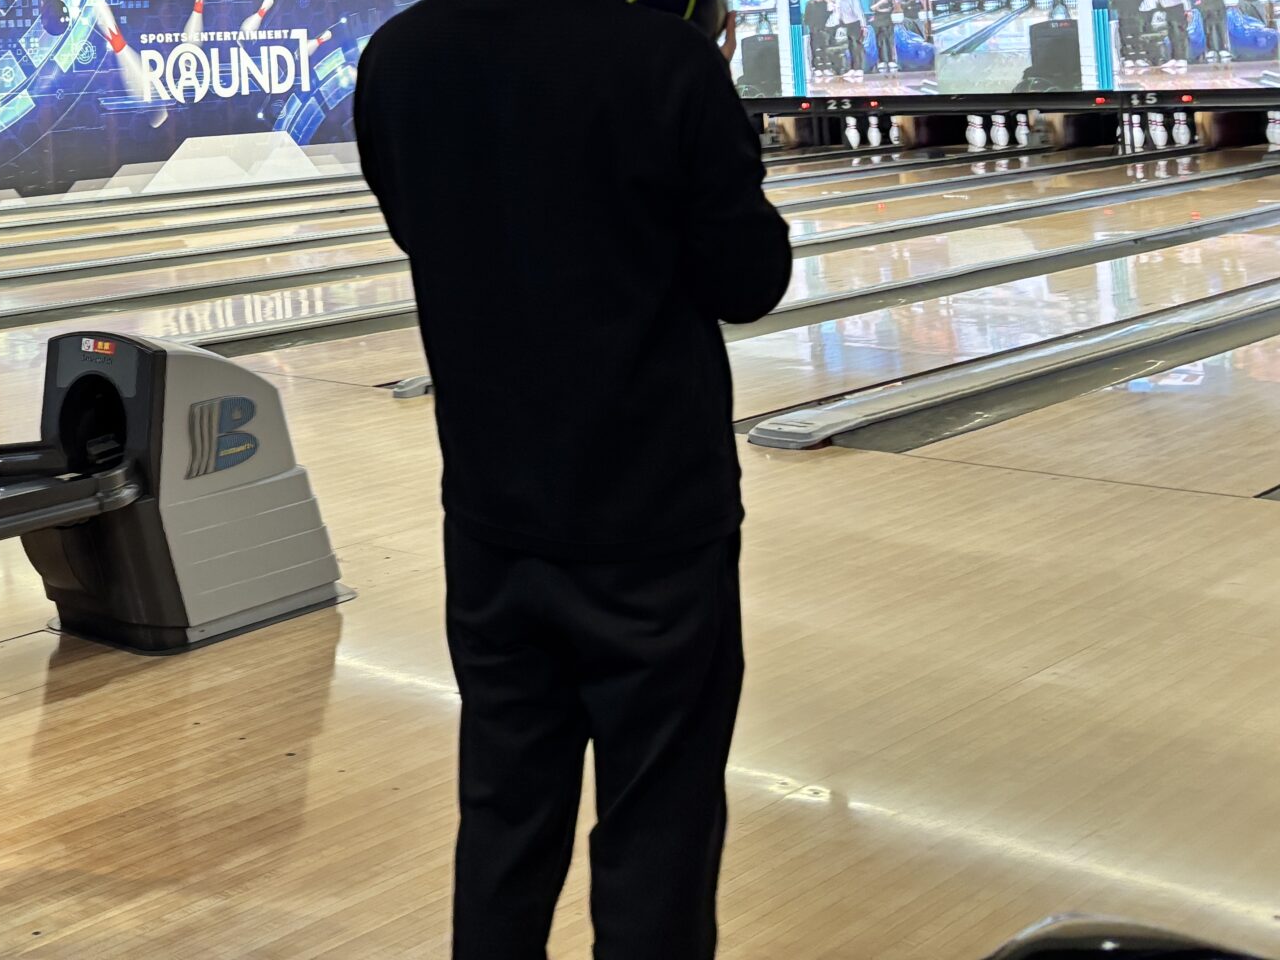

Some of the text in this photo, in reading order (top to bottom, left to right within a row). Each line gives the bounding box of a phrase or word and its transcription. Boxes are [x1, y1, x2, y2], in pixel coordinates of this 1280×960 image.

[140, 29, 289, 44] SPORTS ENTERTAINMENT
[140, 28, 311, 104] ROUND1
